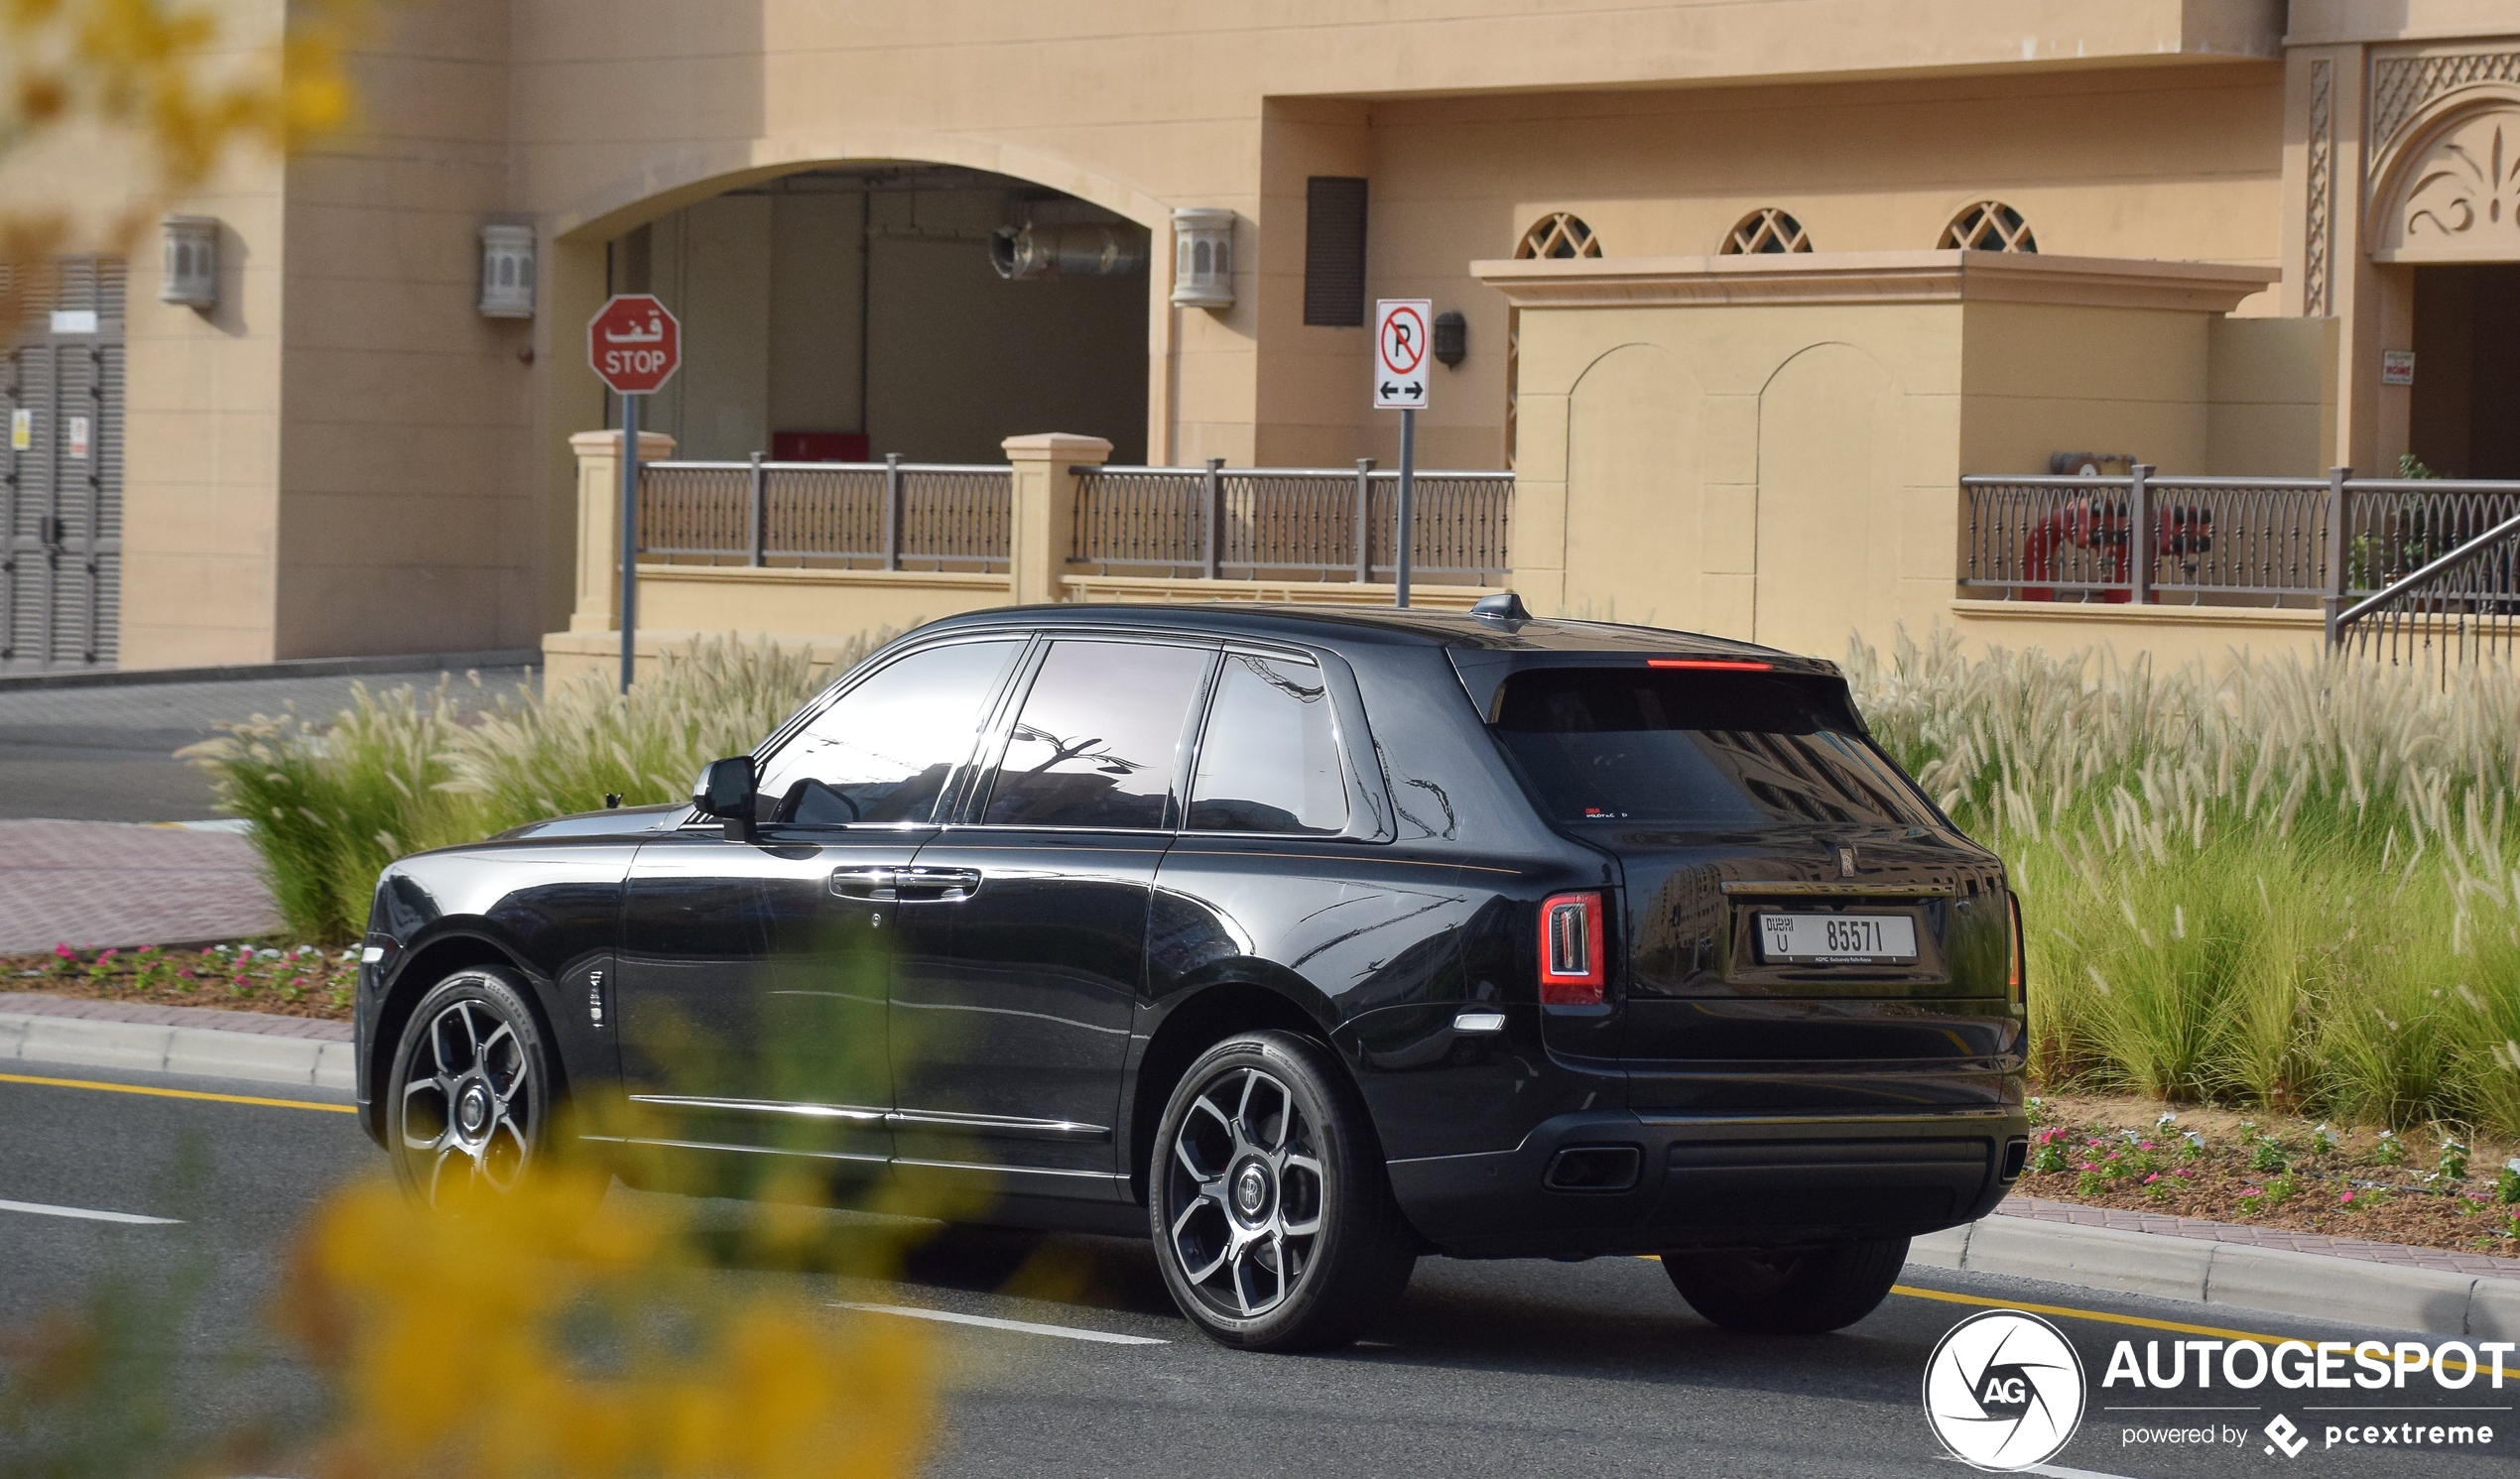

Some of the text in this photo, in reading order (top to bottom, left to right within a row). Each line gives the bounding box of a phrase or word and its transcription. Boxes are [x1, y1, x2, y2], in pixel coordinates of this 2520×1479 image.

[605, 309, 664, 343] قف
[605, 349, 667, 374] STOP
[1777, 934, 1789, 952] U
[1827, 920, 1882, 952] 85571
